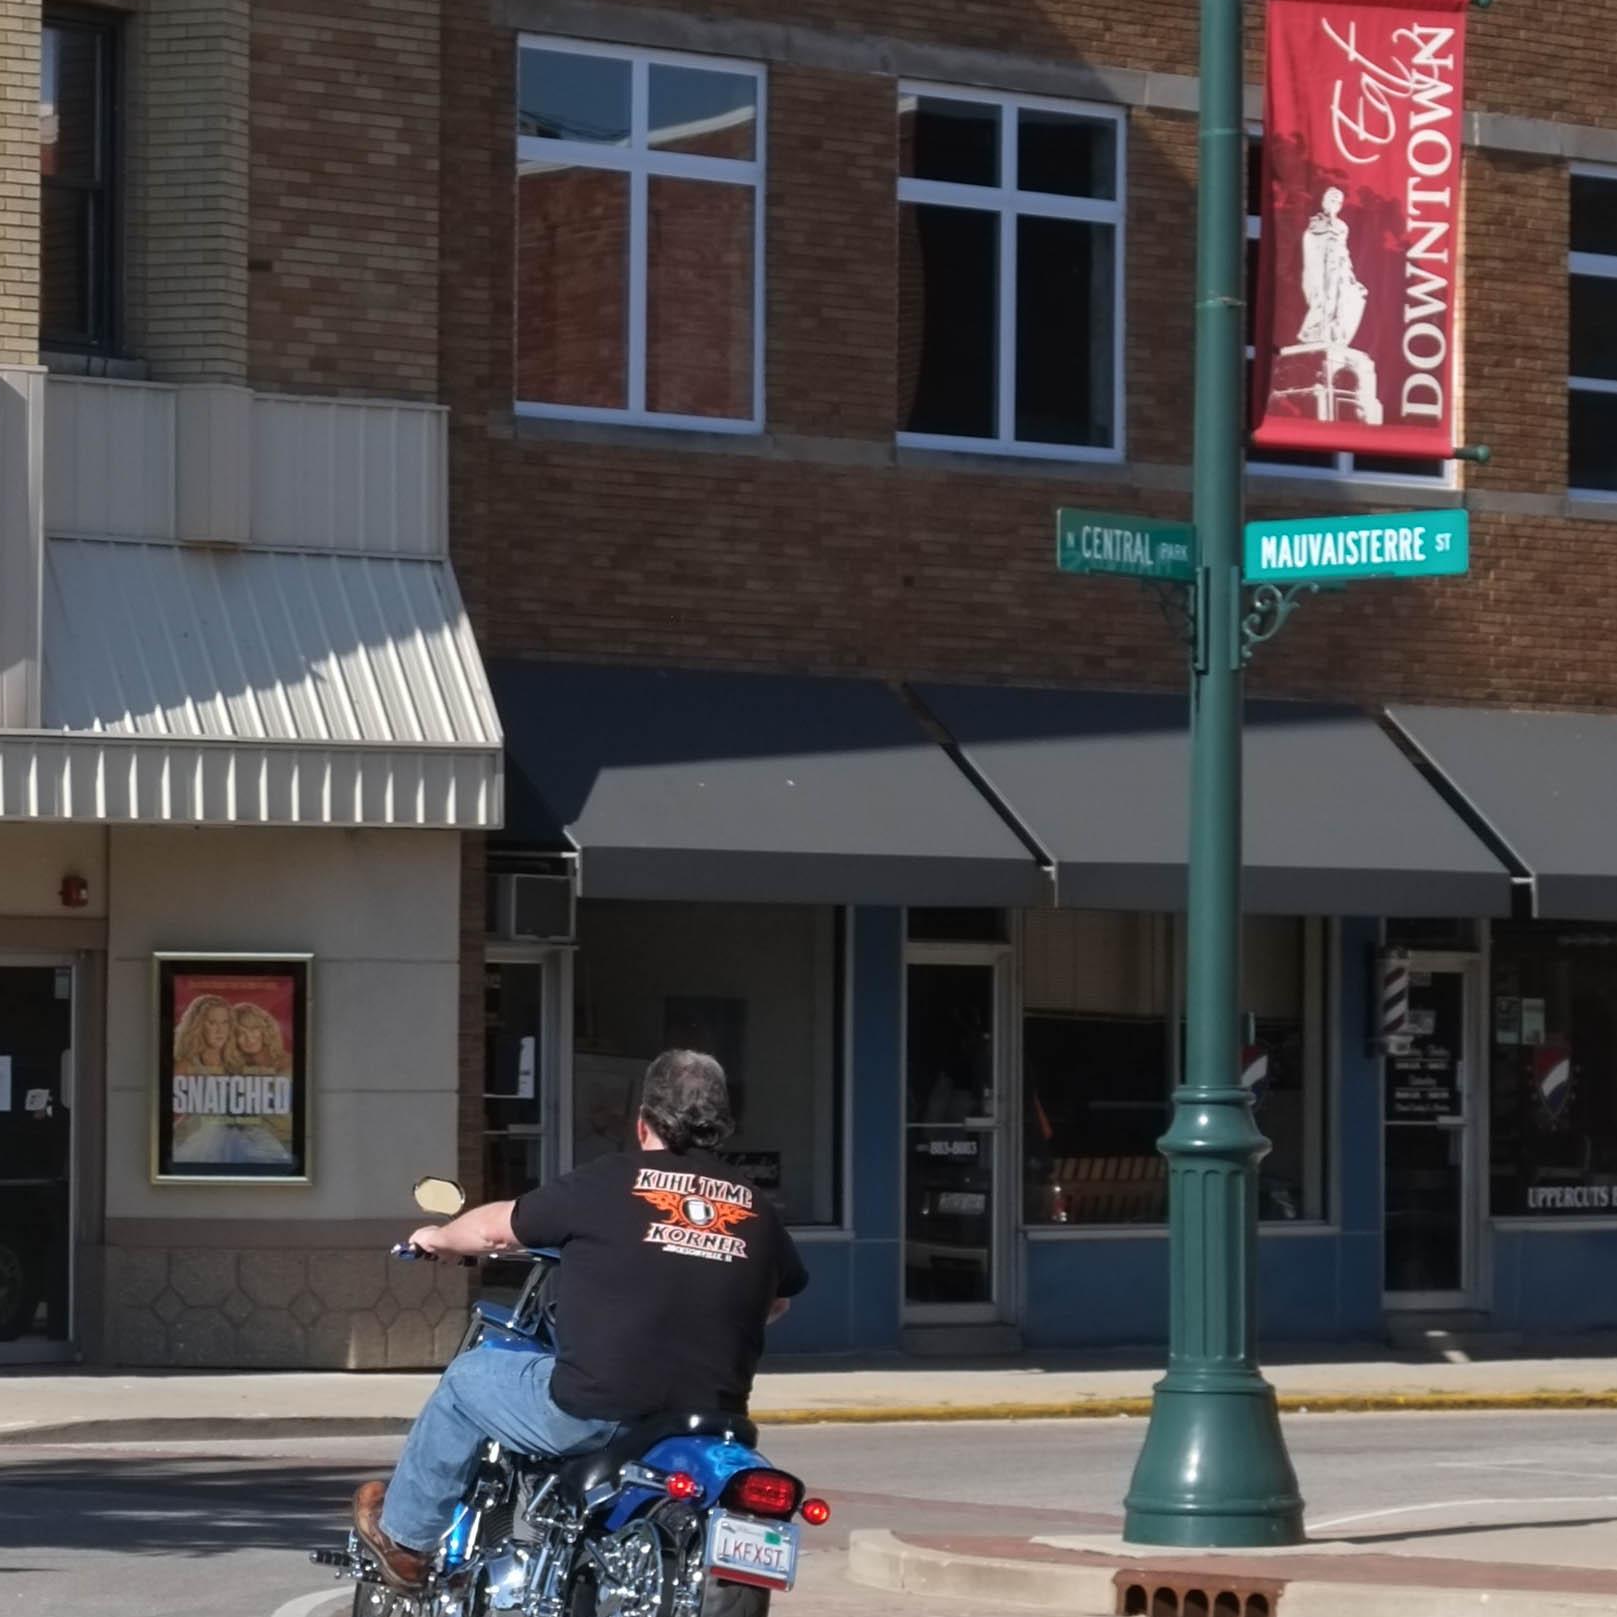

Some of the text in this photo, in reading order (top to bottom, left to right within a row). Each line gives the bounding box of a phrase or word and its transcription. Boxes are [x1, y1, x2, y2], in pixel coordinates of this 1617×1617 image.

[1401, 24, 1455, 420] DOWNTOWN
[1066, 525, 1189, 565] N CENTRAL PARK
[1261, 527, 1452, 569] MAUVAISTERRE ST
[173, 1075, 290, 1114] SNATCHED
[634, 1168, 752, 1209] KUHL TYME
[1528, 1186, 1608, 1208] UPPERCUTS
[644, 1222, 749, 1259] KORNER
